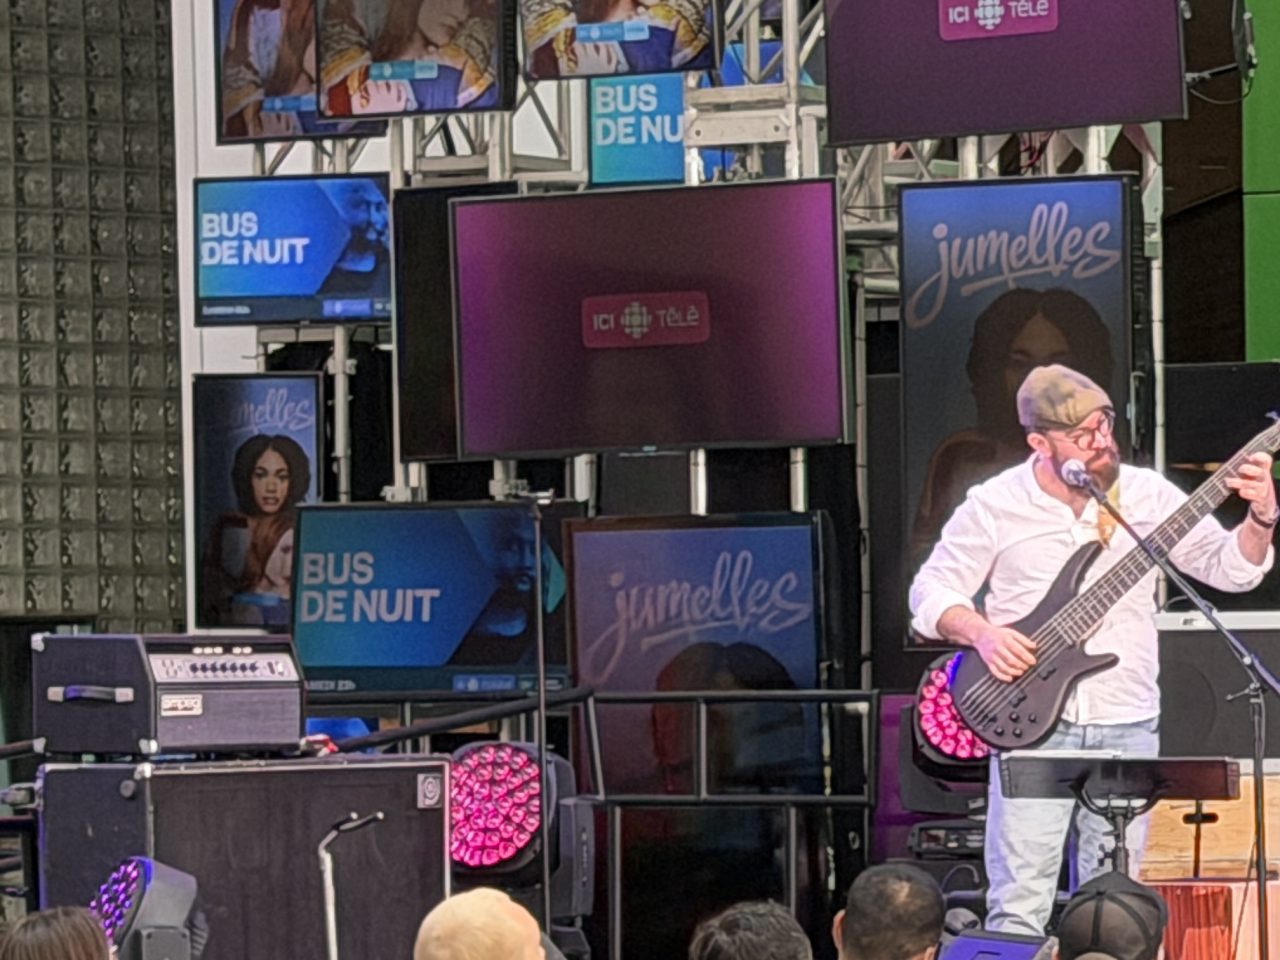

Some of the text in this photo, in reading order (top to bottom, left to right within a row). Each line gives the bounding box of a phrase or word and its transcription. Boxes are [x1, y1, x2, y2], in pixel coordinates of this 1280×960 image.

[948, 6, 970, 24] ICI
[595, 83, 658, 114] BUS
[595, 116, 637, 145] DE
[201, 211, 258, 239] BUS
[201, 237, 310, 265] DE NUIT
[904, 201, 1121, 330] jumelles
[593, 313, 615, 331] ICI
[302, 551, 374, 585] BUS
[300, 588, 440, 624] DE NUIT
[578, 550, 812, 686] jumelles
